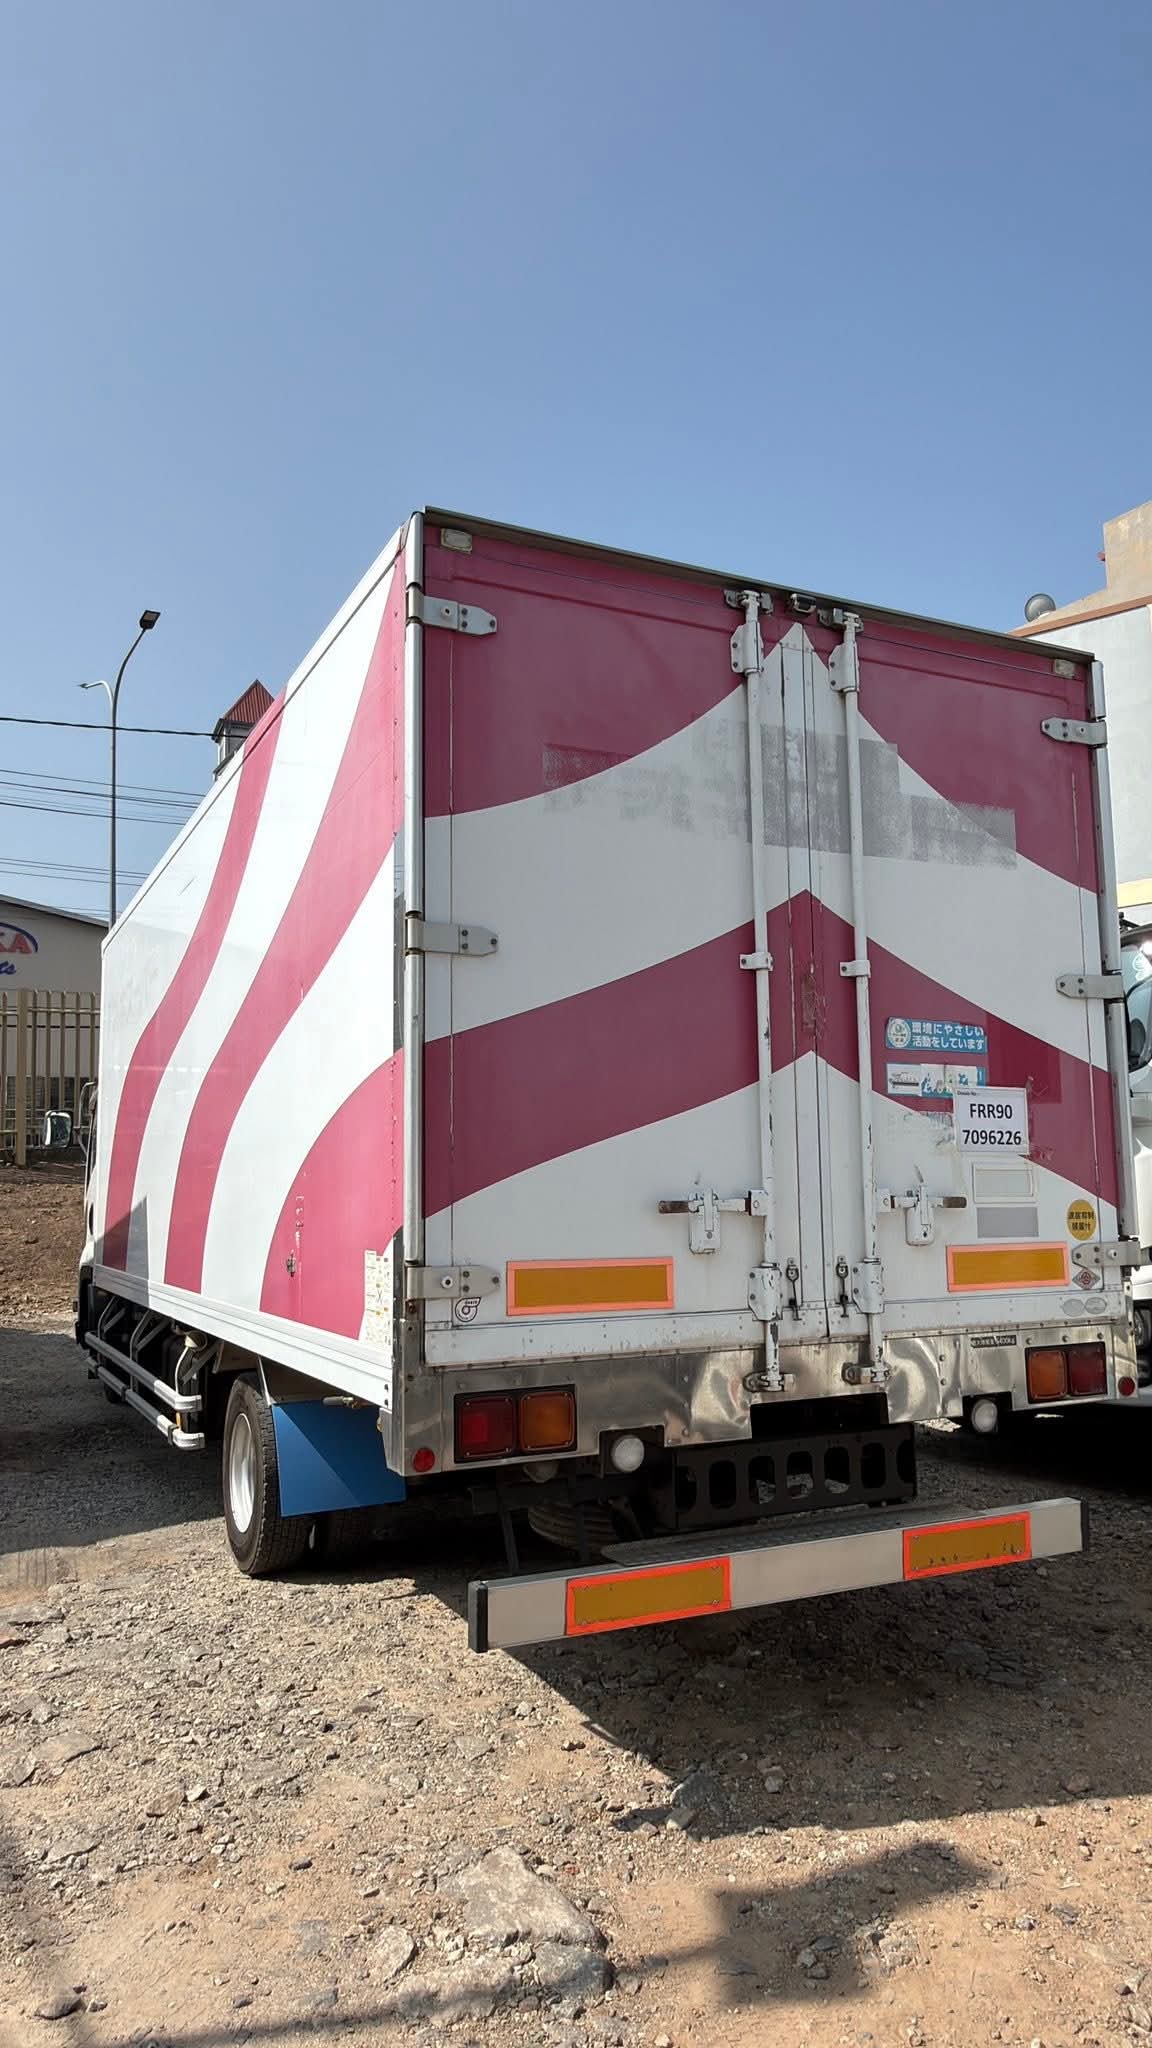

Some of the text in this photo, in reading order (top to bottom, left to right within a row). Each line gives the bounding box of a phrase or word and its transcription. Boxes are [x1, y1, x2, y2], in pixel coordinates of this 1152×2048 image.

[911, 1021, 984, 1036] 環境にやさしい
[912, 1035, 985, 1050] 活動をしています
[969, 1103, 1013, 1119] FRR90
[962, 1129, 1022, 1146] 7096226
